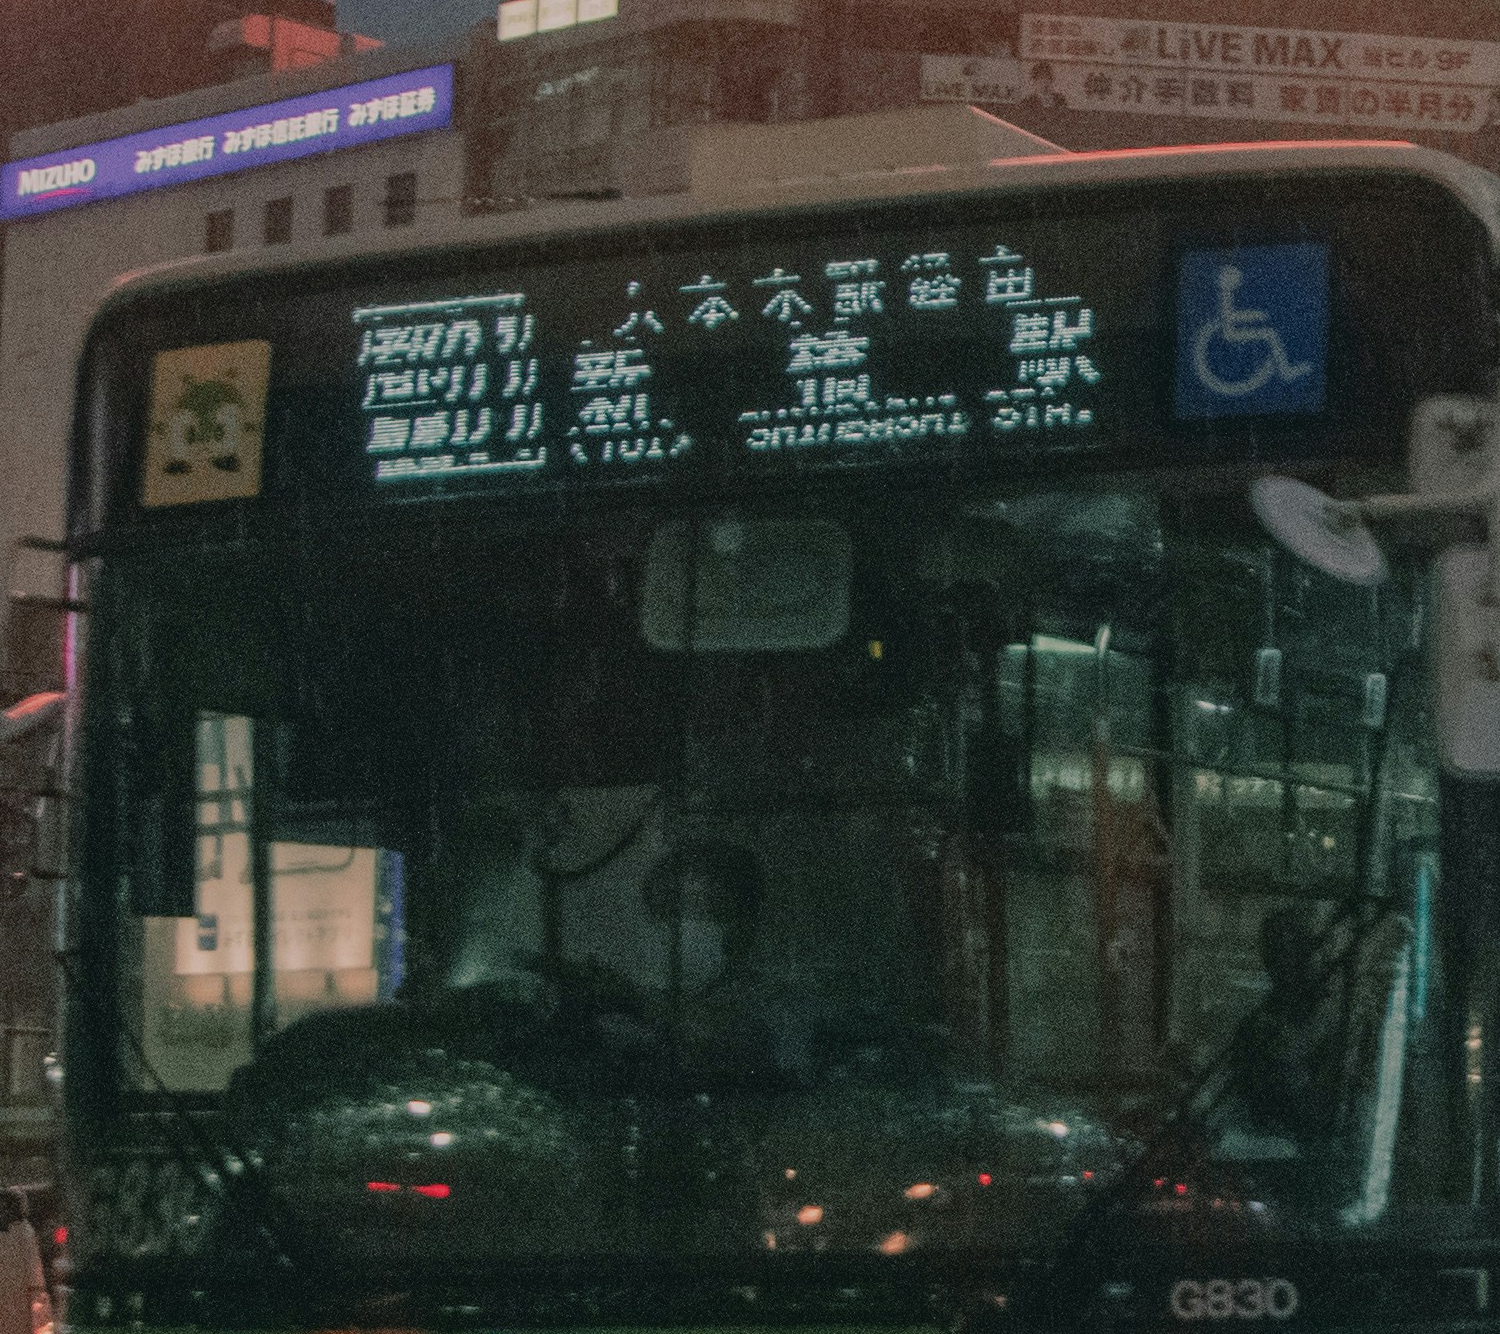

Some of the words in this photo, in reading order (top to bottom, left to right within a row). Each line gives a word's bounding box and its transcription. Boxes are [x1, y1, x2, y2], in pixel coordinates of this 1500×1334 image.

[1252, 33, 1345, 70] MAX
[17, 158, 96, 197] MIZUHO
[134, 134, 215, 175] みずほ銀行
[222, 108, 341, 155] みずほ信託銀行
[348, 85, 437, 130] みずほ証券
[1170, 1278, 1299, 1321] G830
